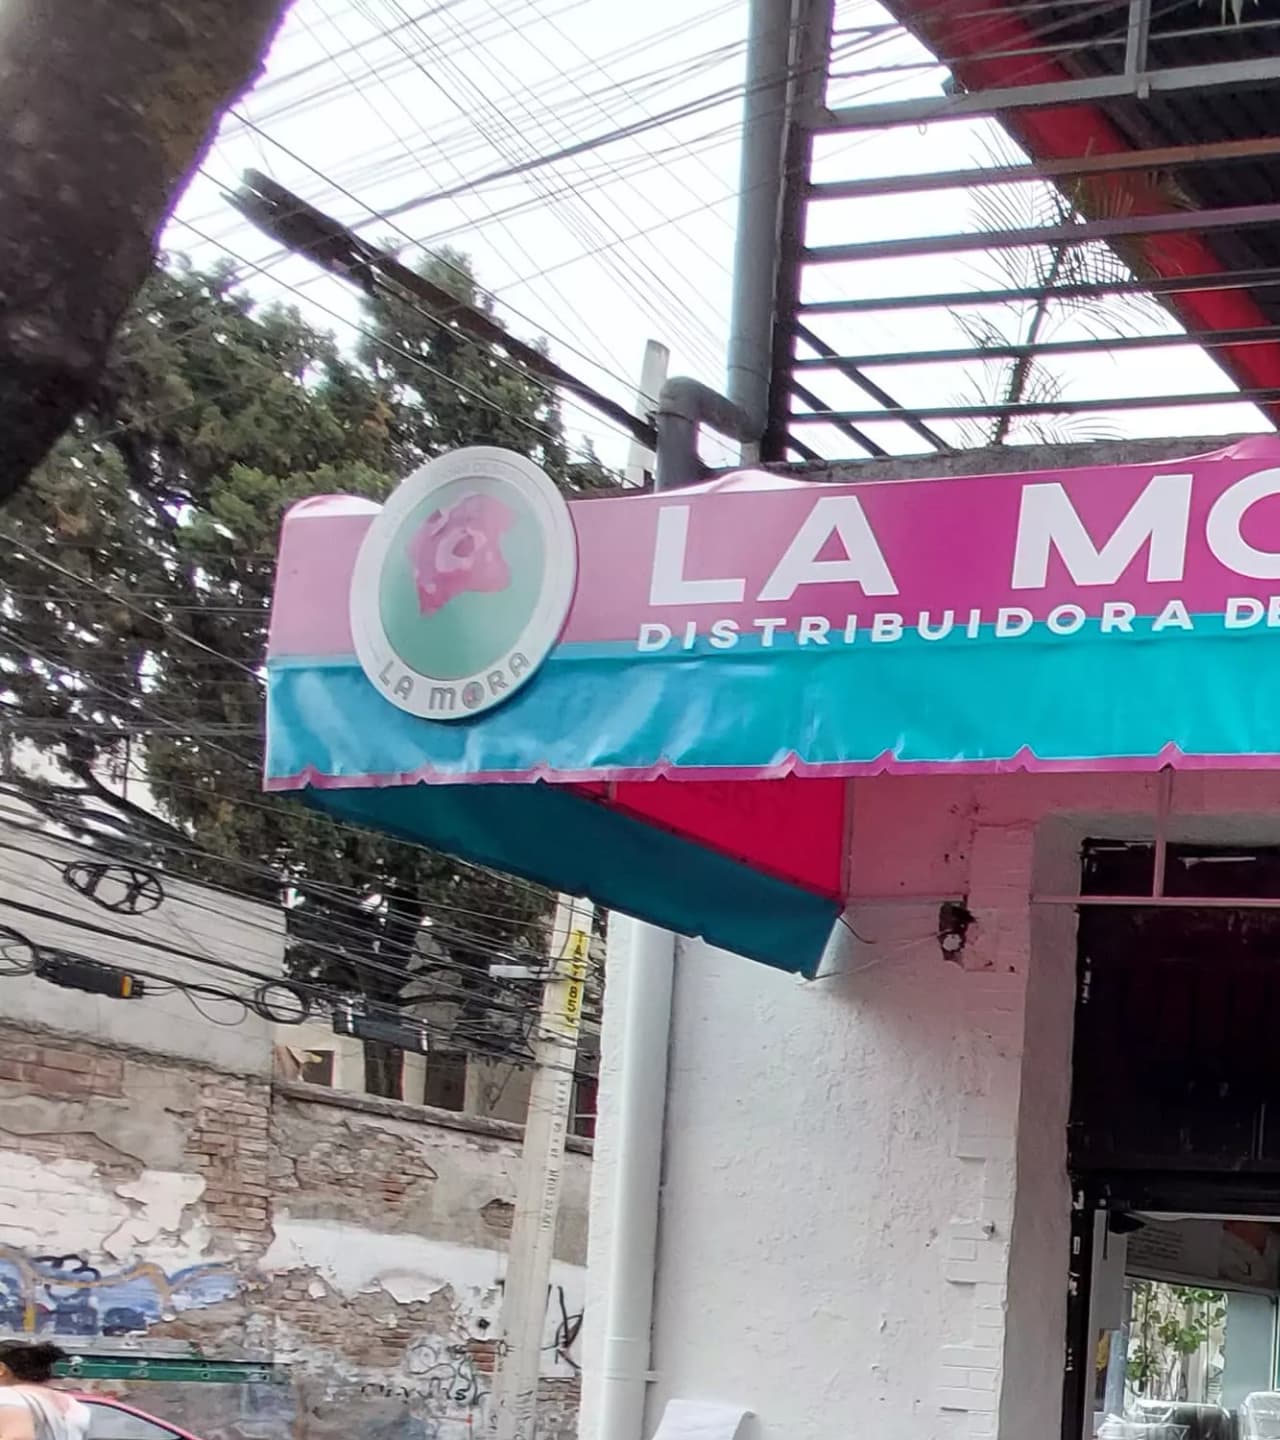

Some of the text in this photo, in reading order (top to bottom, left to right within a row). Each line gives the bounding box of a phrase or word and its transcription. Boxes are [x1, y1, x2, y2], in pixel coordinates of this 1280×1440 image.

[648, 494, 900, 607] LA
[636, 598, 1195, 654] DISTRIBUIDORA
[377, 660, 415, 701] LA
